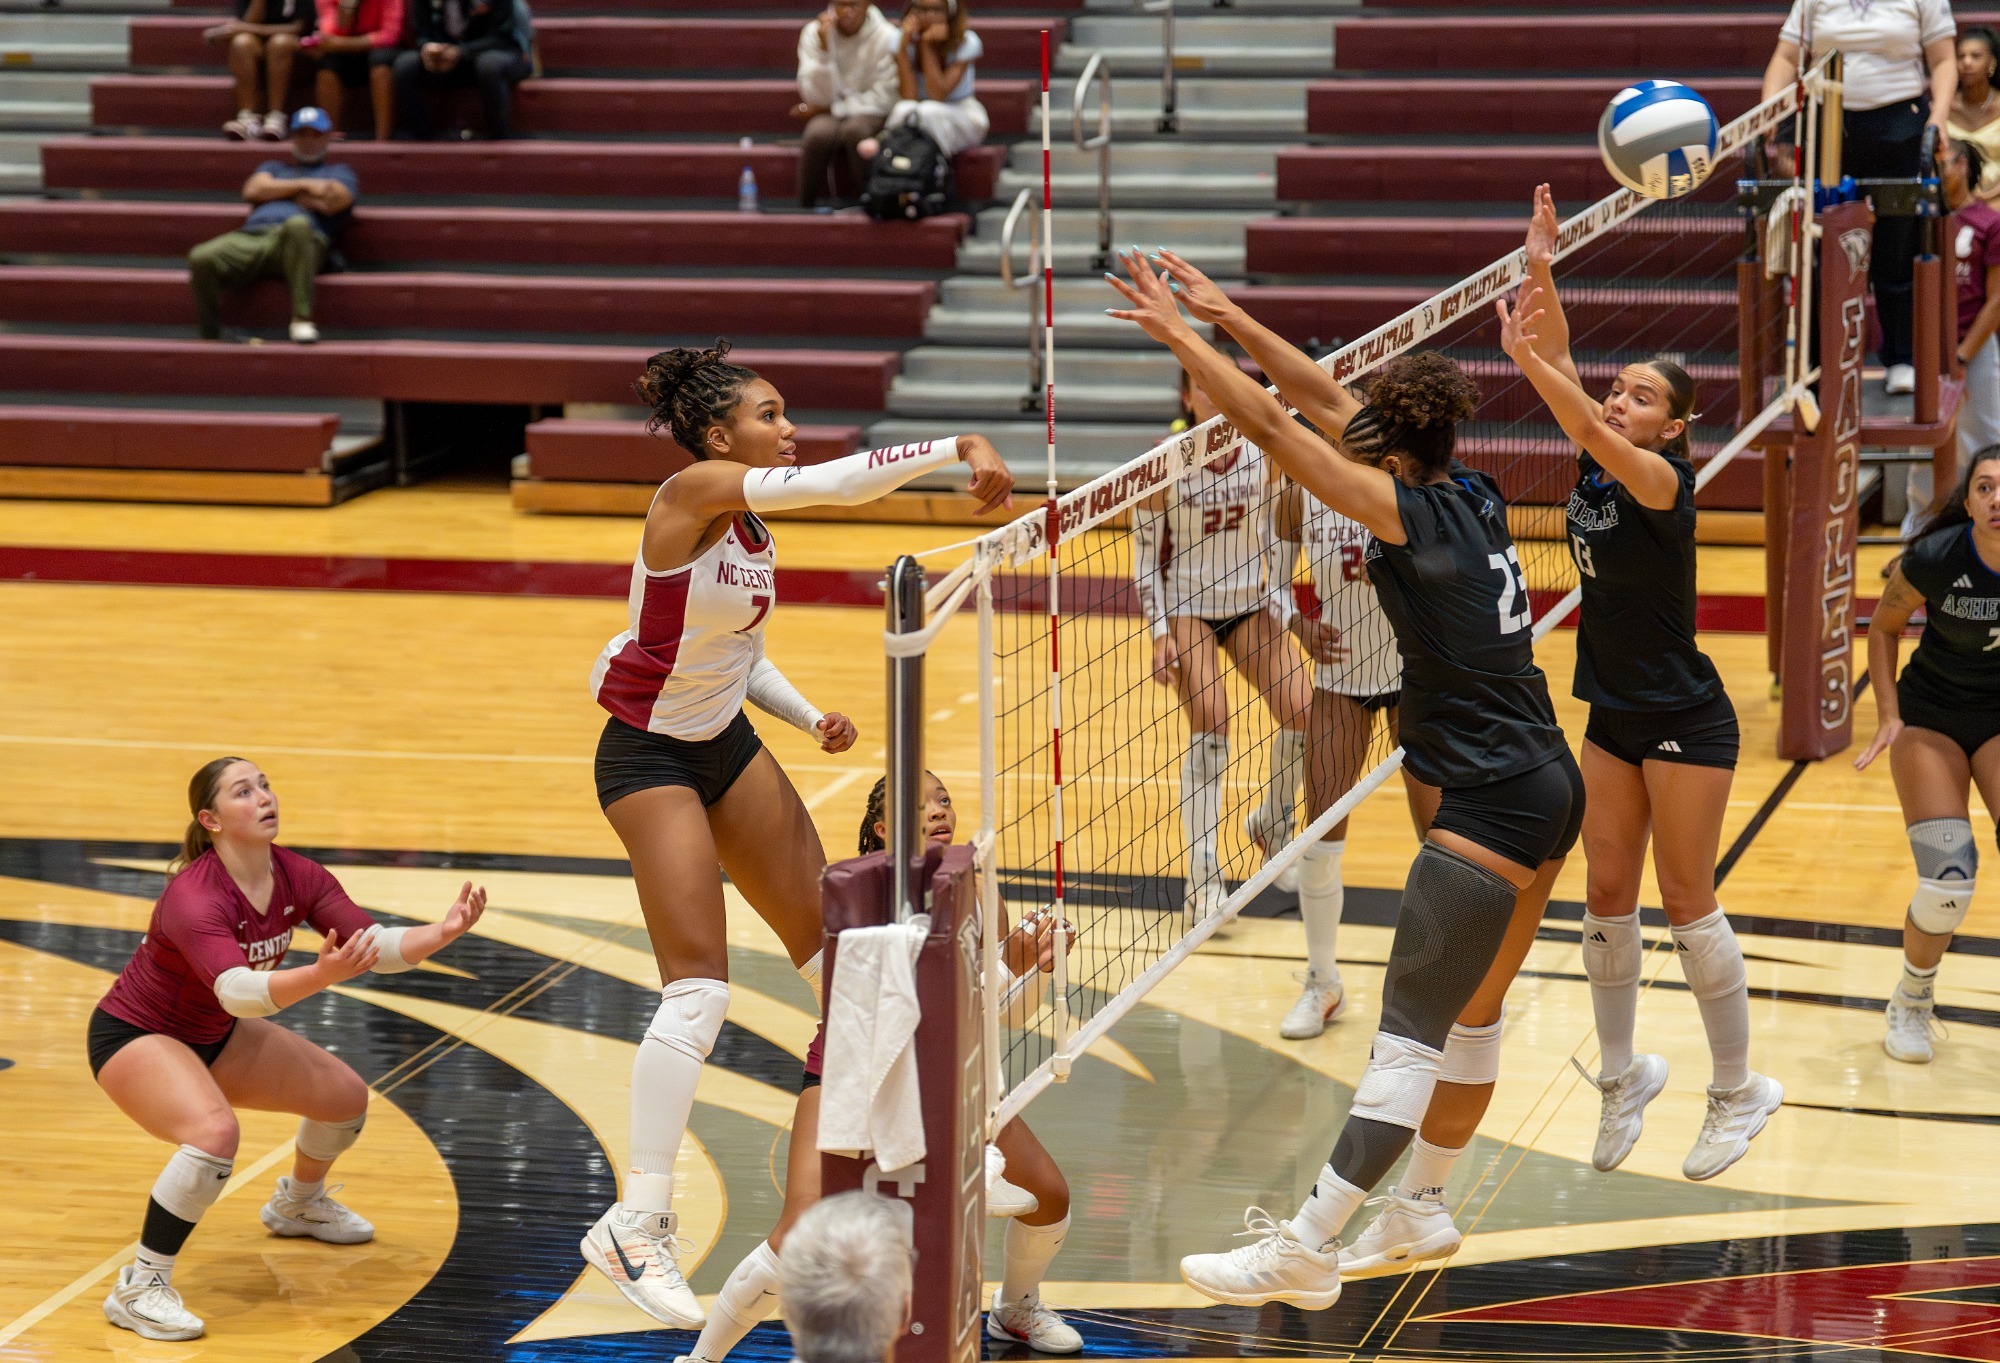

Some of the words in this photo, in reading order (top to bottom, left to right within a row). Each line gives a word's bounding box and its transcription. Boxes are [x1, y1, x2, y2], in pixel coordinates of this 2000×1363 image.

[1204, 503, 1246, 536] 22
[717, 561, 738, 586] NC
[740, 567, 775, 590] CENT
[739, 594, 771, 633] 7
[1940, 593, 2000, 621] ASHE
